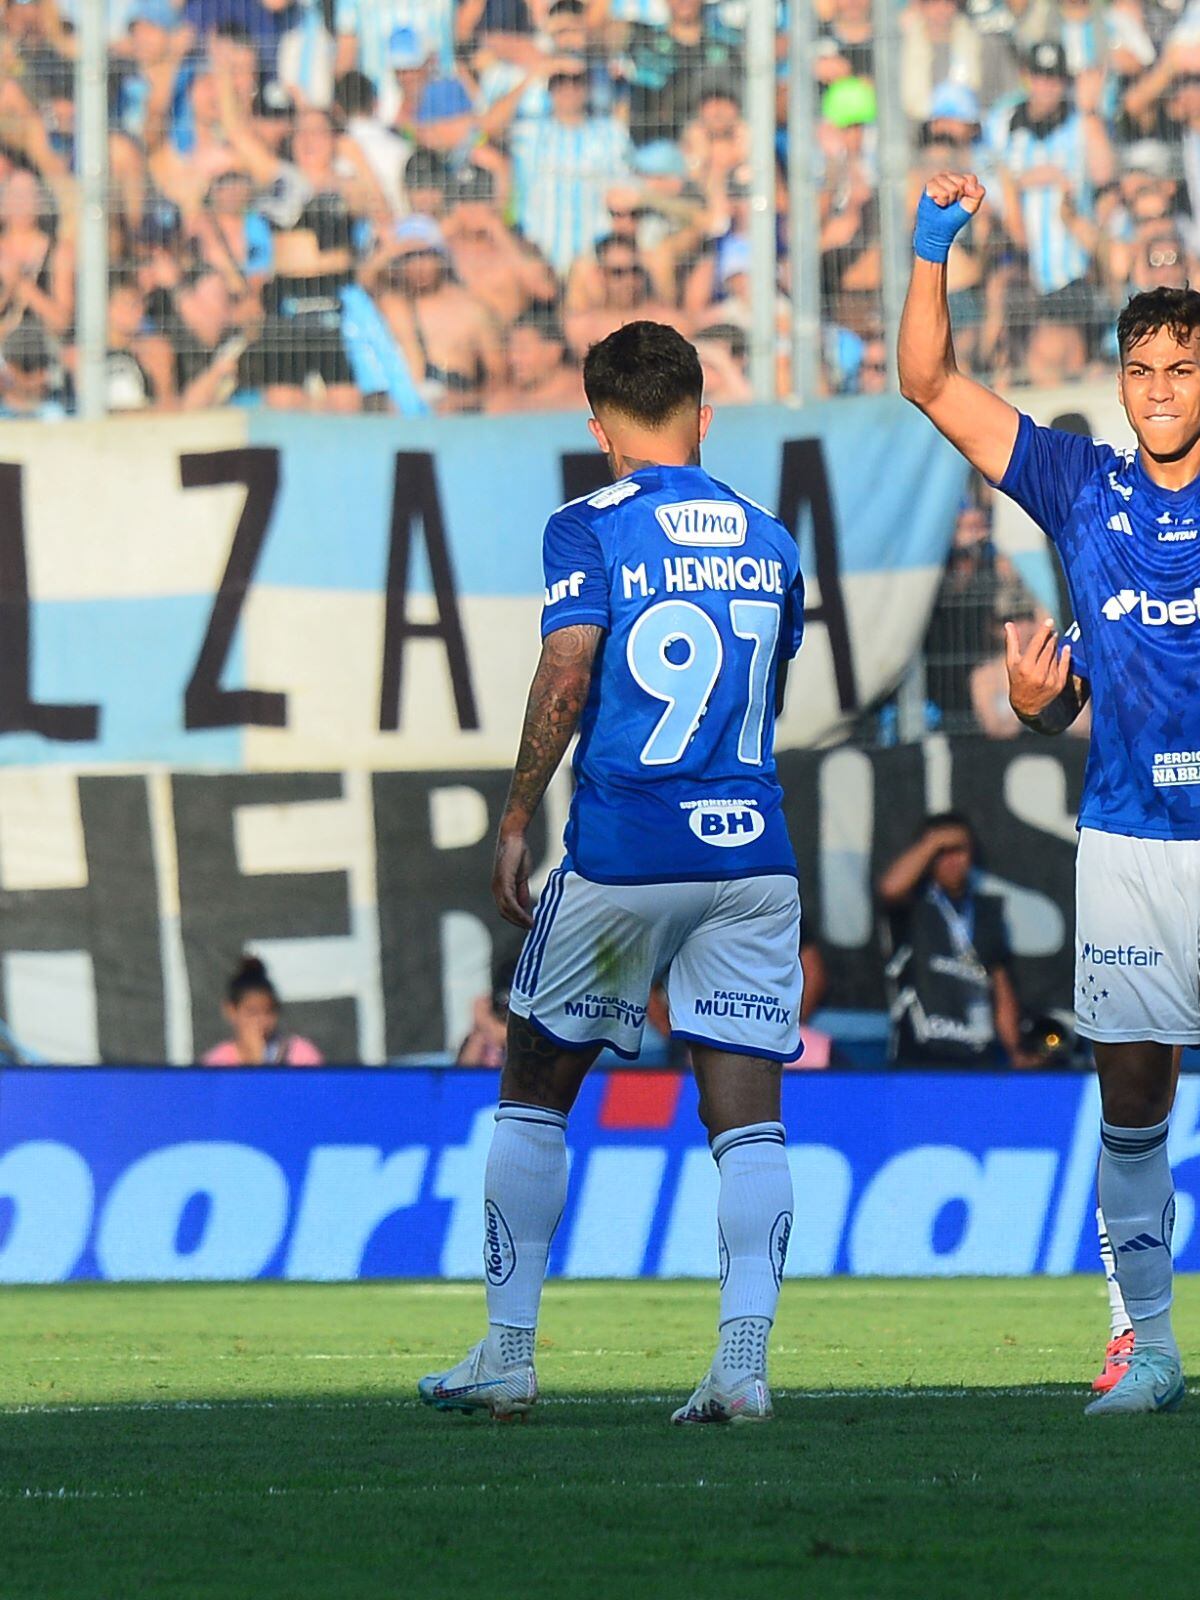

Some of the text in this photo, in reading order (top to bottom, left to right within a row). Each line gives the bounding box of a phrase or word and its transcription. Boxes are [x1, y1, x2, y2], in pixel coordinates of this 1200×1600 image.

[664, 508, 738, 535] Vilma
[621, 556, 784, 599] M. HENRIQUE
[626, 599, 780, 766] 97
[1152, 768, 1177, 783] NA
[701, 811, 755, 836] BH
[1092, 945, 1164, 967] betfair
[713, 990, 780, 1006] FACULDADE
[694, 998, 791, 1026] MULTIVIX
[486, 1206, 503, 1277] Kodilar
